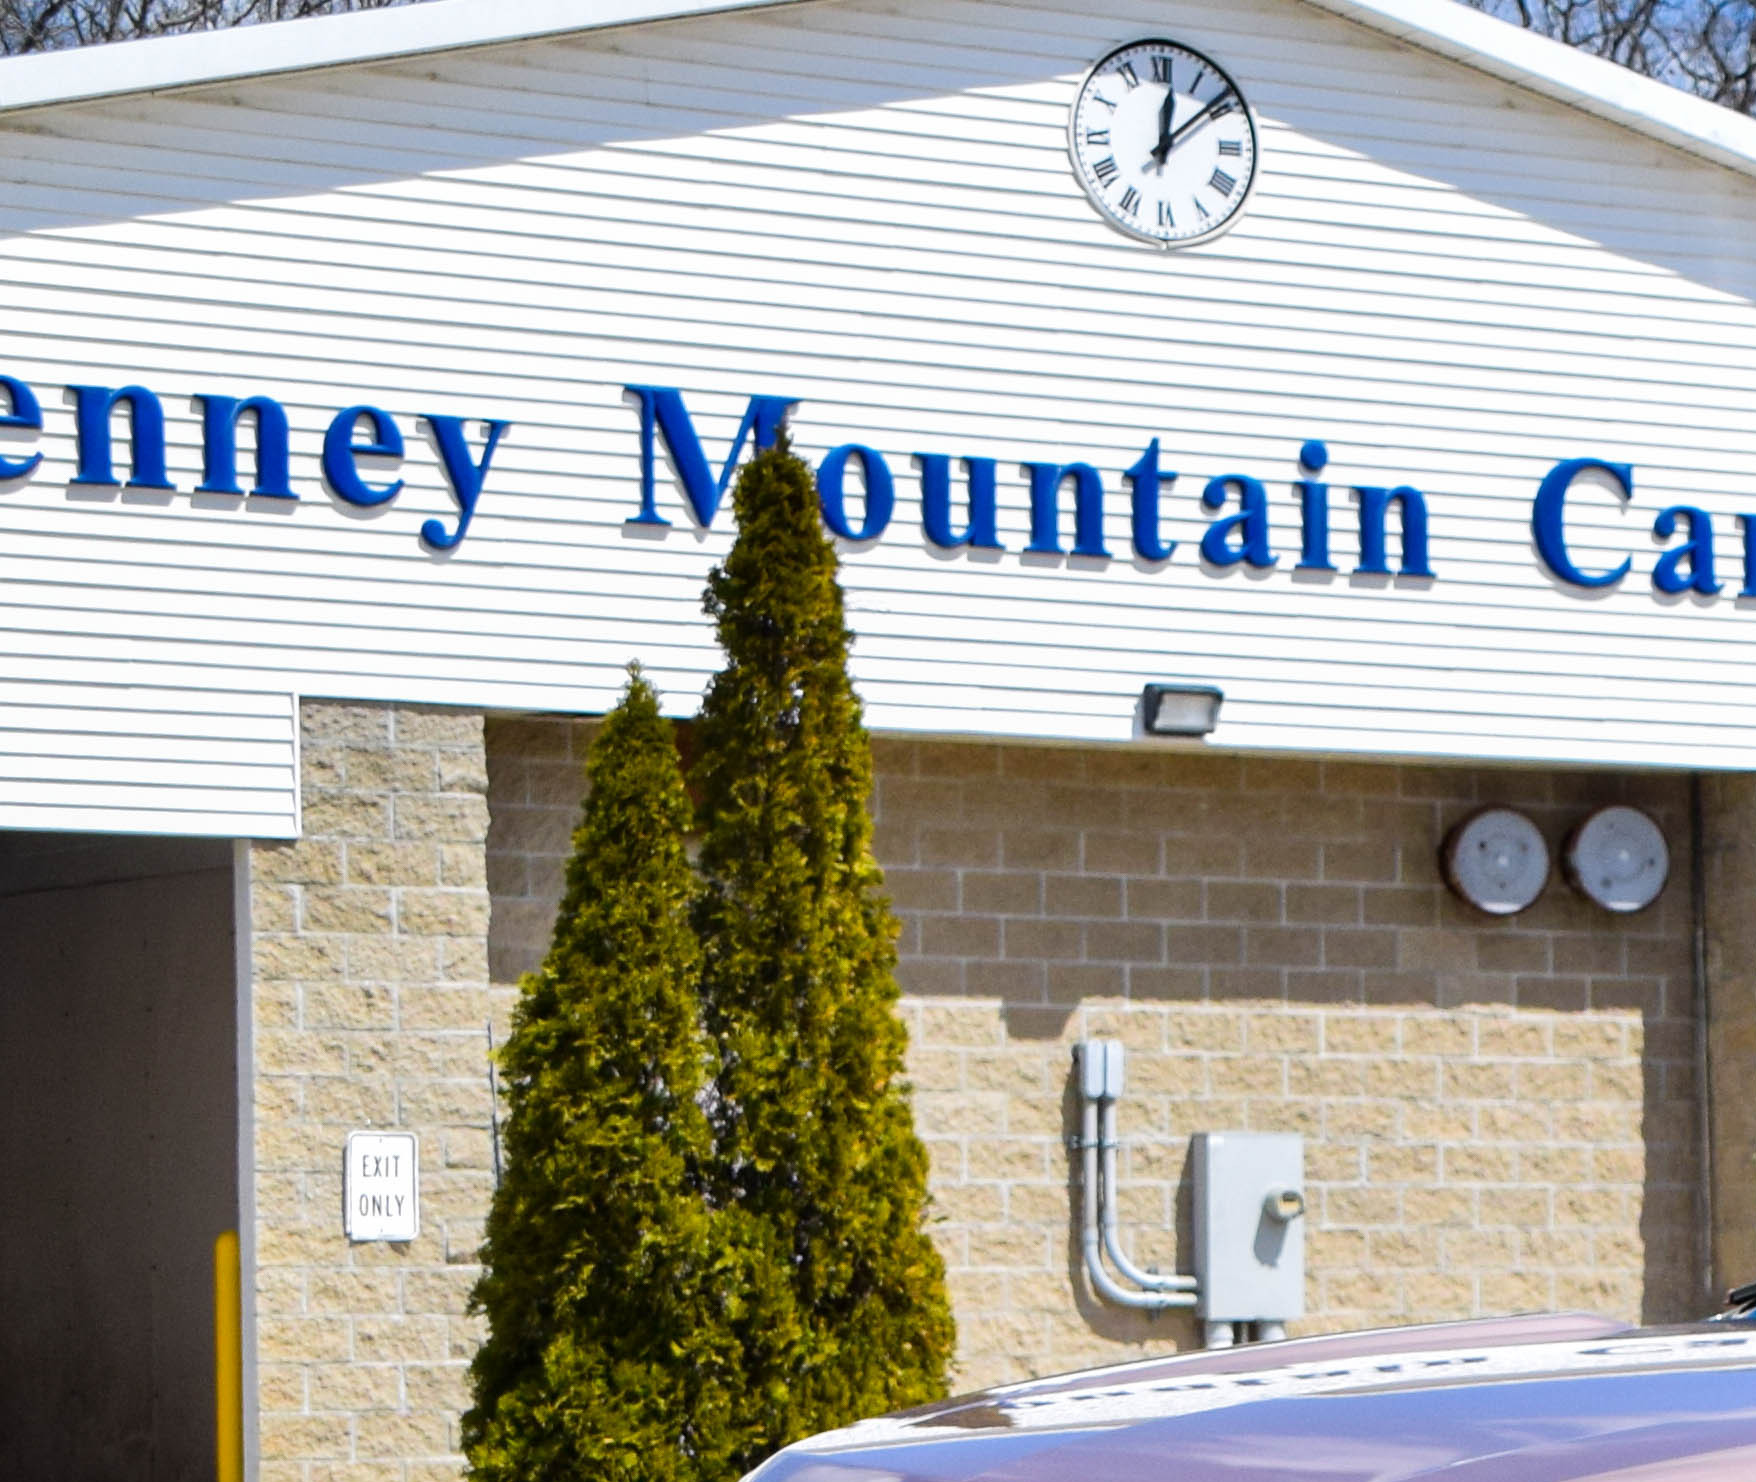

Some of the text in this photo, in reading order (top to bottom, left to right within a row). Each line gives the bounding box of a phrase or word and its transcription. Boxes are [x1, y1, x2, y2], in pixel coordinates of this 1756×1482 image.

[1150, 56, 1173, 83] XII
[1218, 139, 1242, 157] III
[623, 383, 1435, 576] Mountain
[362, 1154, 400, 1178] EXIT
[359, 1193, 405, 1217] ONLY
